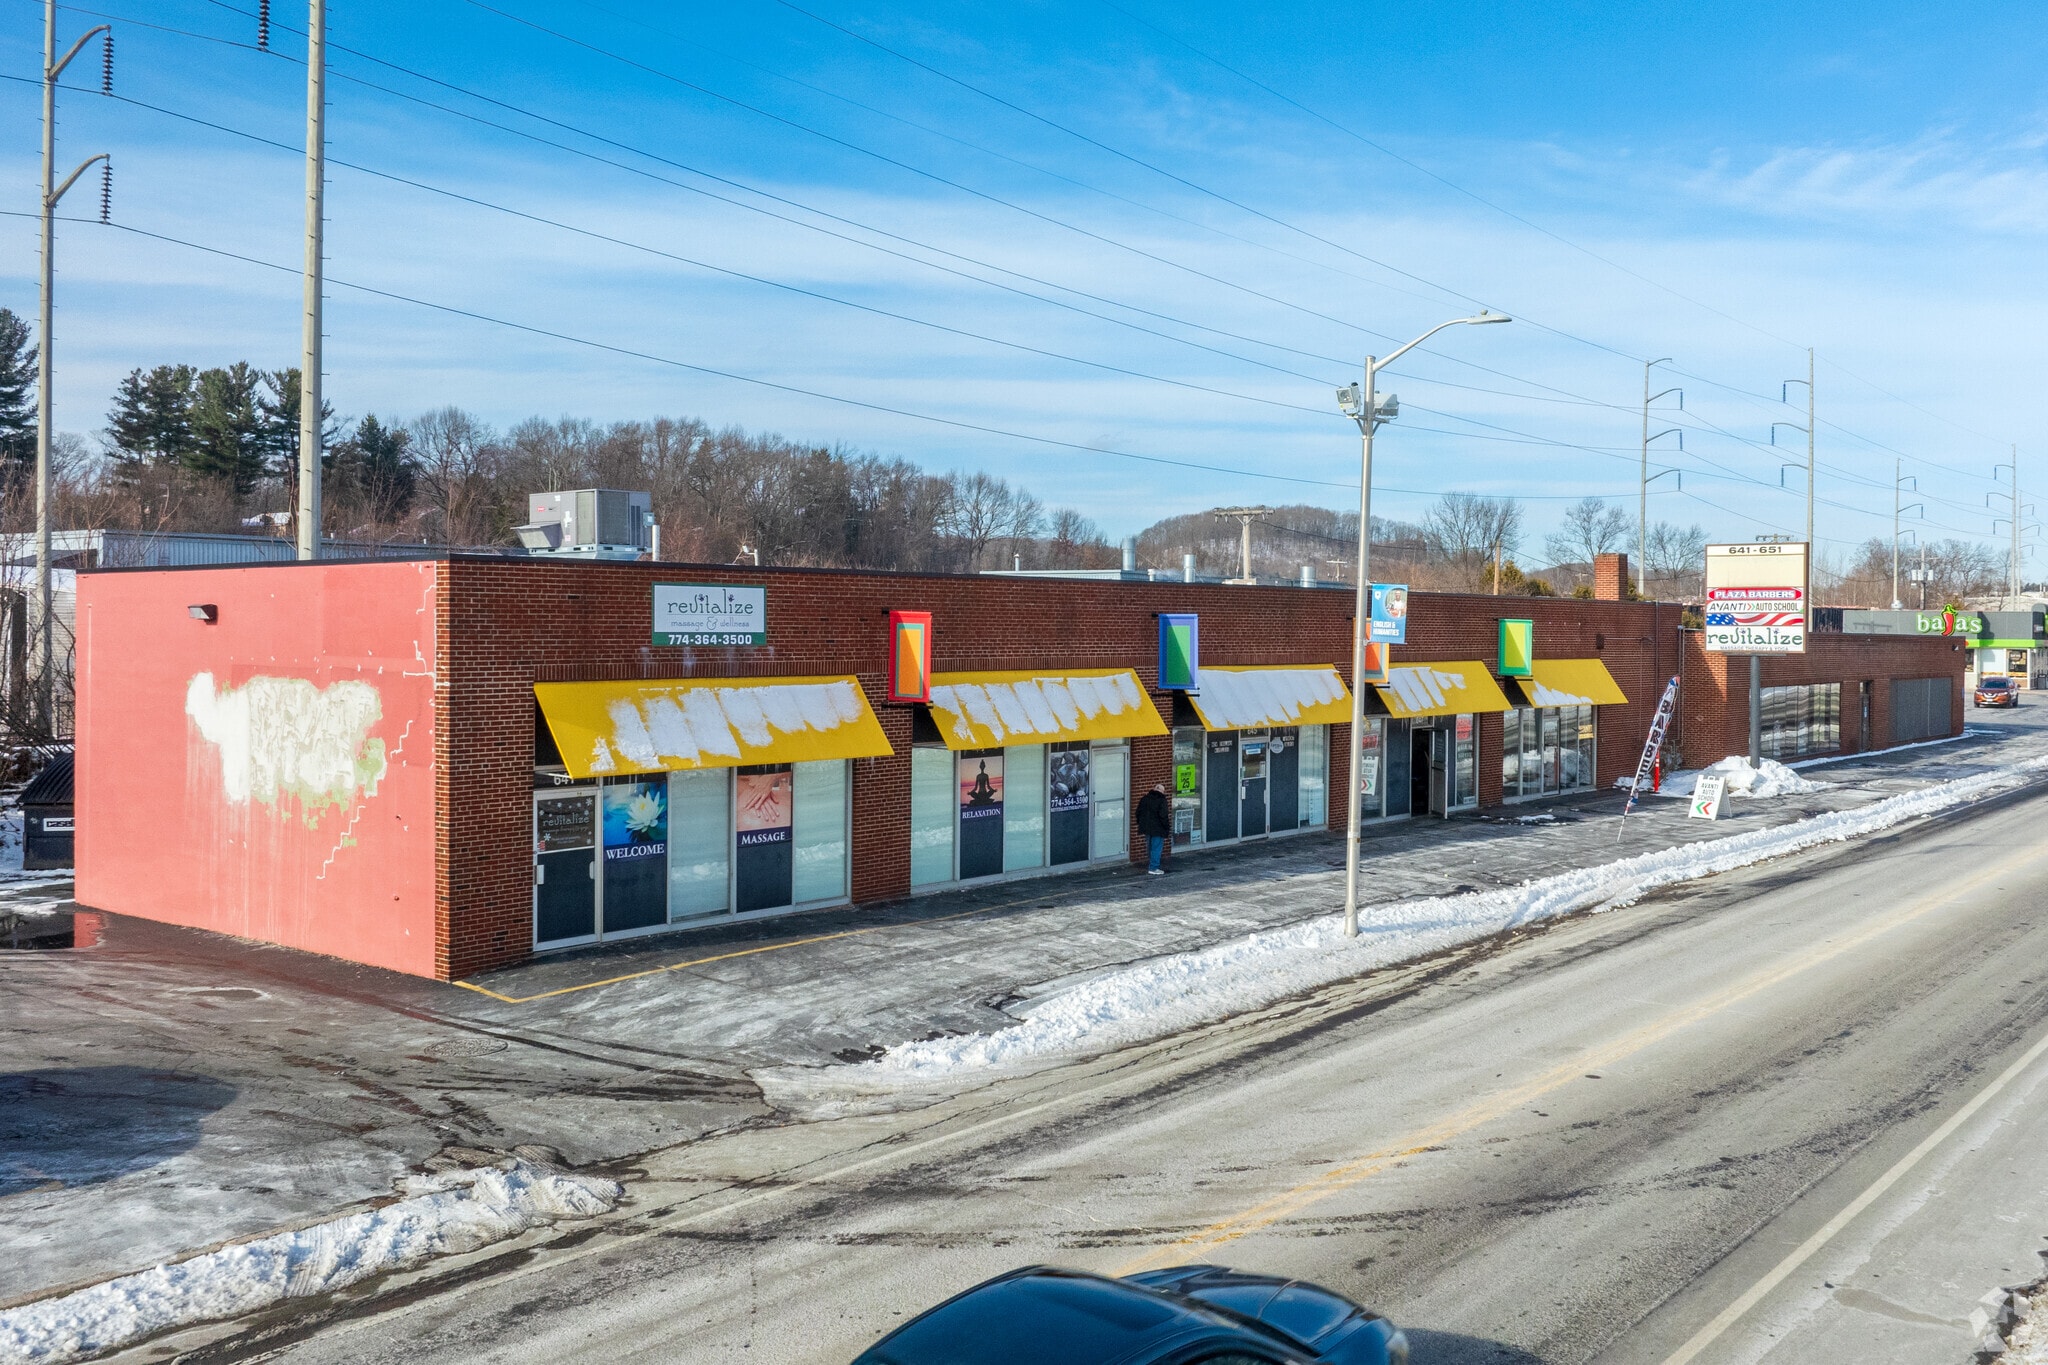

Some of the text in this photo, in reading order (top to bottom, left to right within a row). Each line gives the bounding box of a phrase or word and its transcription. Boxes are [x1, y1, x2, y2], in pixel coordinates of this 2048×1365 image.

[1759, 546, 1782, 554] 651
[667, 588, 753, 614] revitalize
[1709, 602, 1799, 611] AVANTI AUTO SCHOOL
[671, 616, 750, 631] massage & wellness
[668, 634, 752, 645] 774-364-3500
[1708, 627, 1802, 645] revitalize
[962, 808, 1001, 819] RELAXATION
[741, 831, 786, 845] MASSAGE
[606, 844, 665, 860] WELCOME
